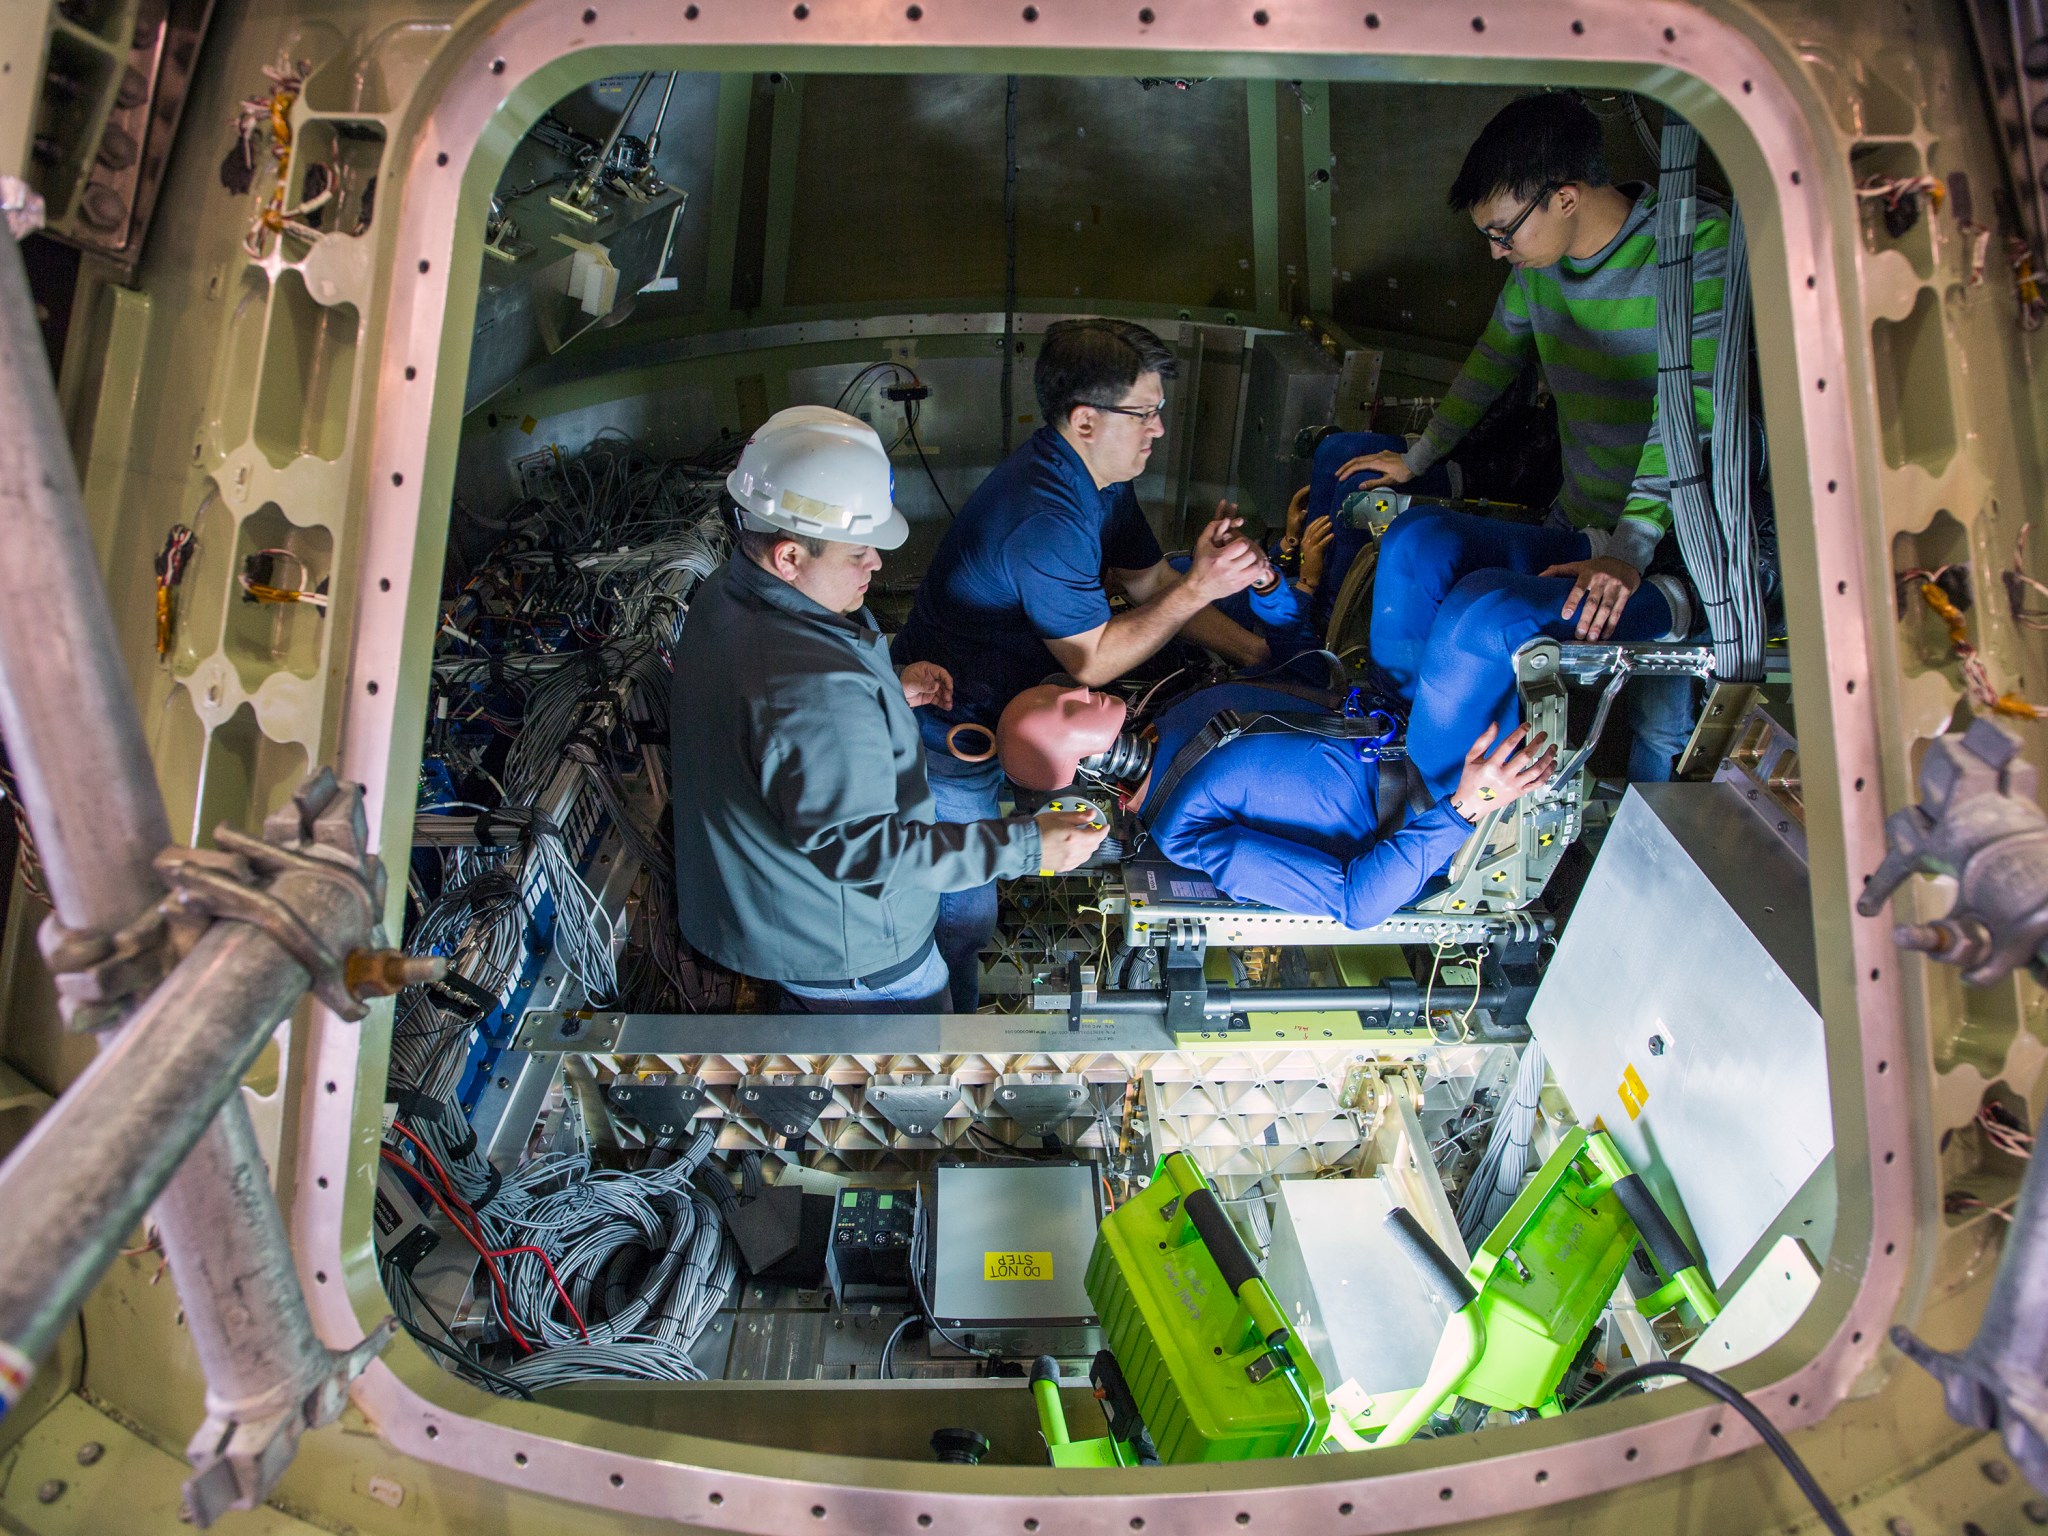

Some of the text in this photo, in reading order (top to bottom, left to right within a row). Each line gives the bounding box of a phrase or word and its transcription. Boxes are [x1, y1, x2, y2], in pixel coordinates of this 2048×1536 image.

[998, 1254, 1033, 1265] STEP
[990, 1265, 1040, 1278] DO NOT
